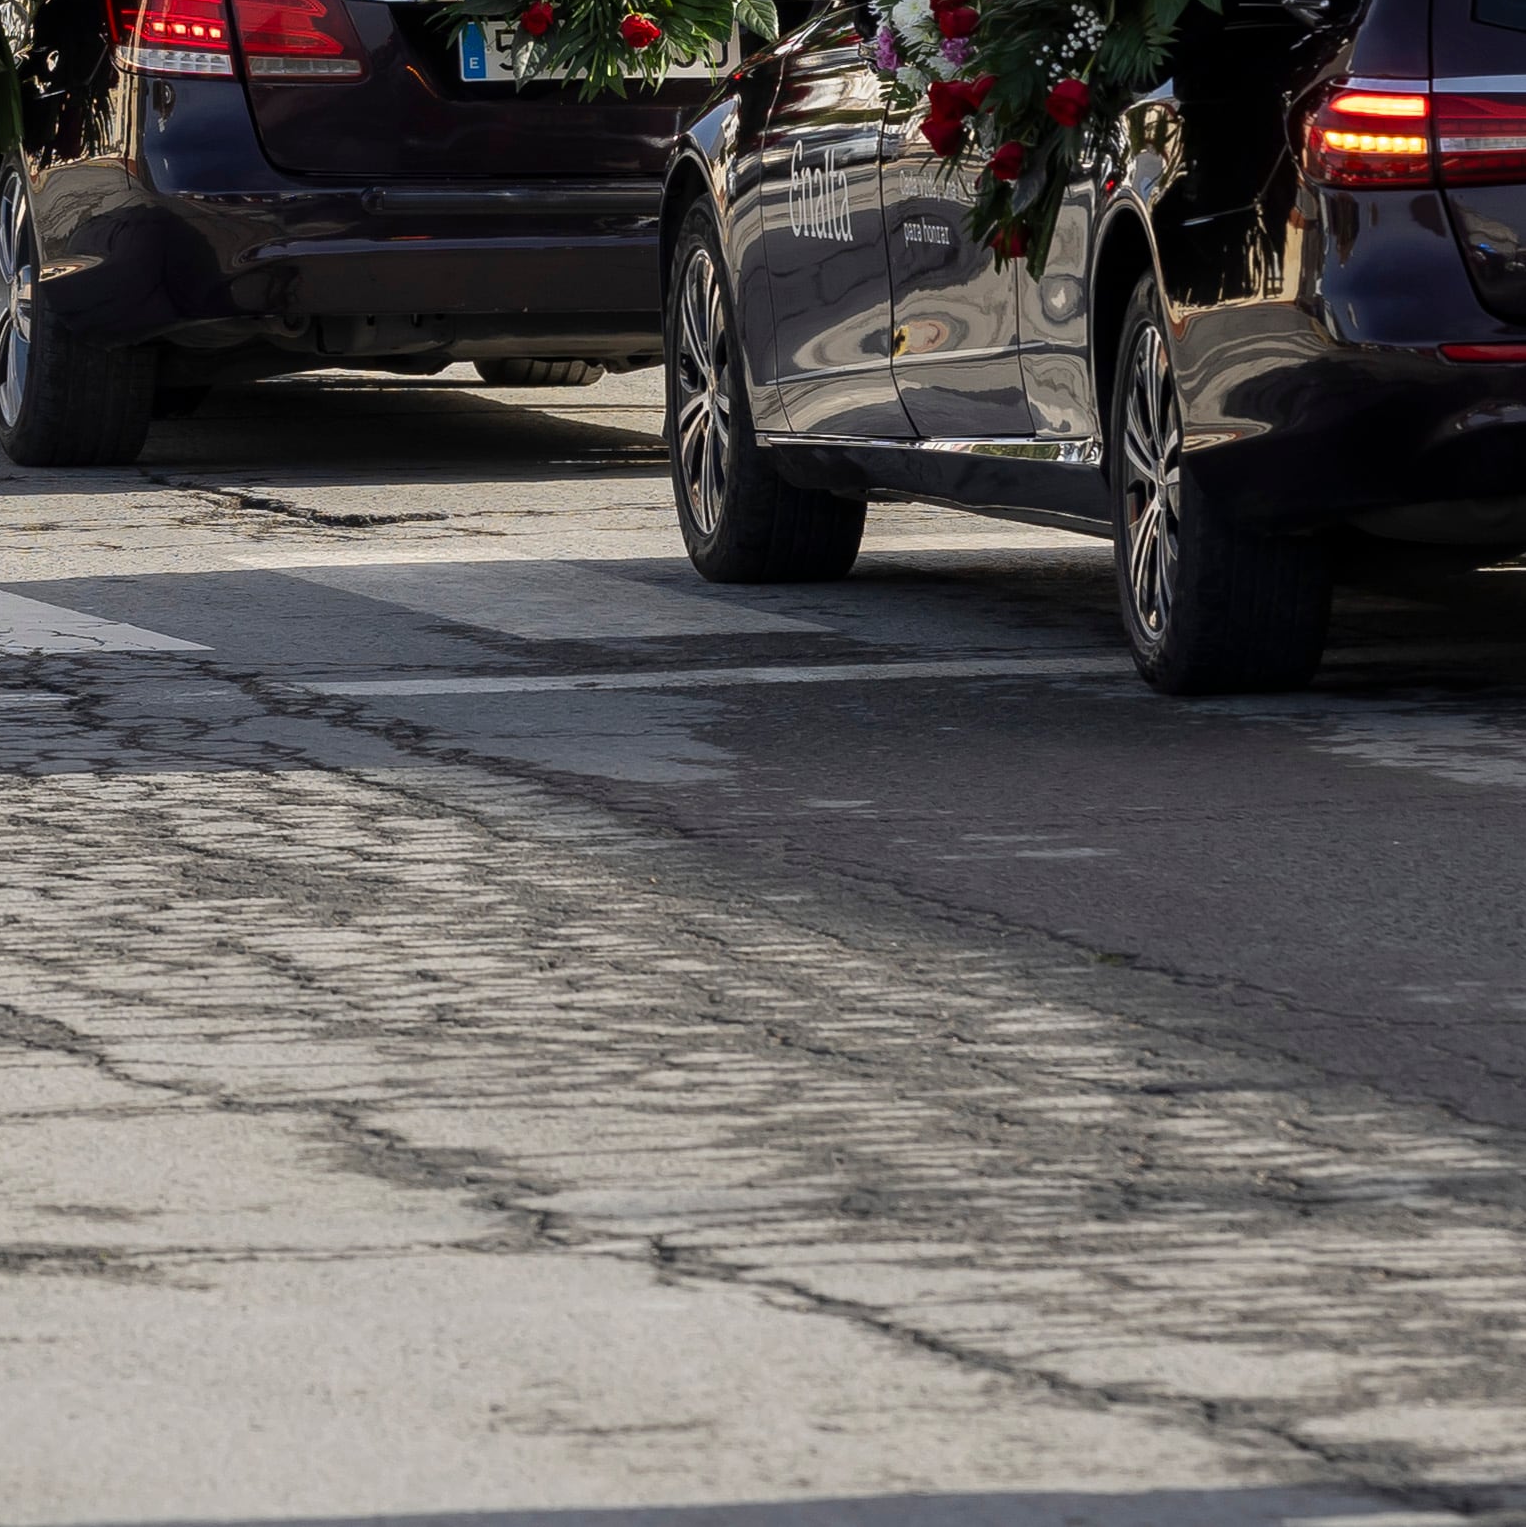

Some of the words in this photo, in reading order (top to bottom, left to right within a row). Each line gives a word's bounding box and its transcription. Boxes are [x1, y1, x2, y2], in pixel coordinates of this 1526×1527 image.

[469, 57, 479, 69] E
[789, 139, 853, 242] Enalta
[903, 222, 922, 248] para
[922, 216, 950, 245] honrar
